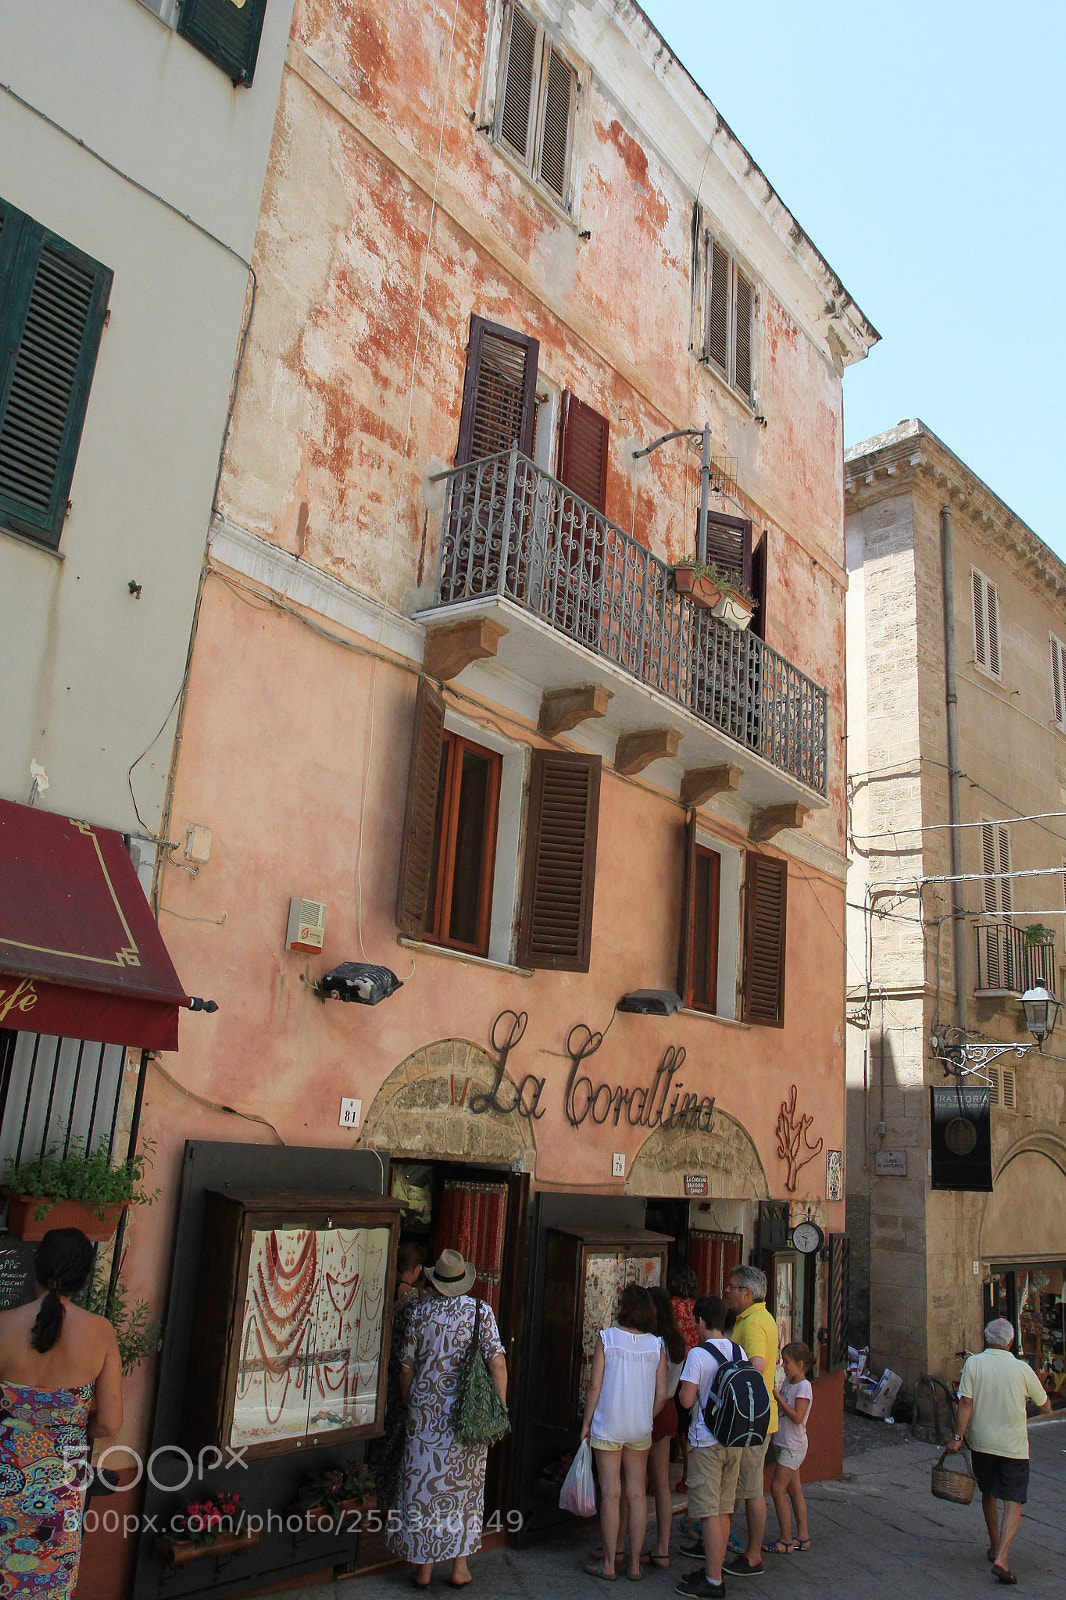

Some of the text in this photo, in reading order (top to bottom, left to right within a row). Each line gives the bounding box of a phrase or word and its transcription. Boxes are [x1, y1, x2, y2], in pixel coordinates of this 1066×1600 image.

[469, 1010, 715, 1133] La Corallina
[934, 1095, 989, 1103] TRATTORIA
[344, 1110, 356, 1123] 81
